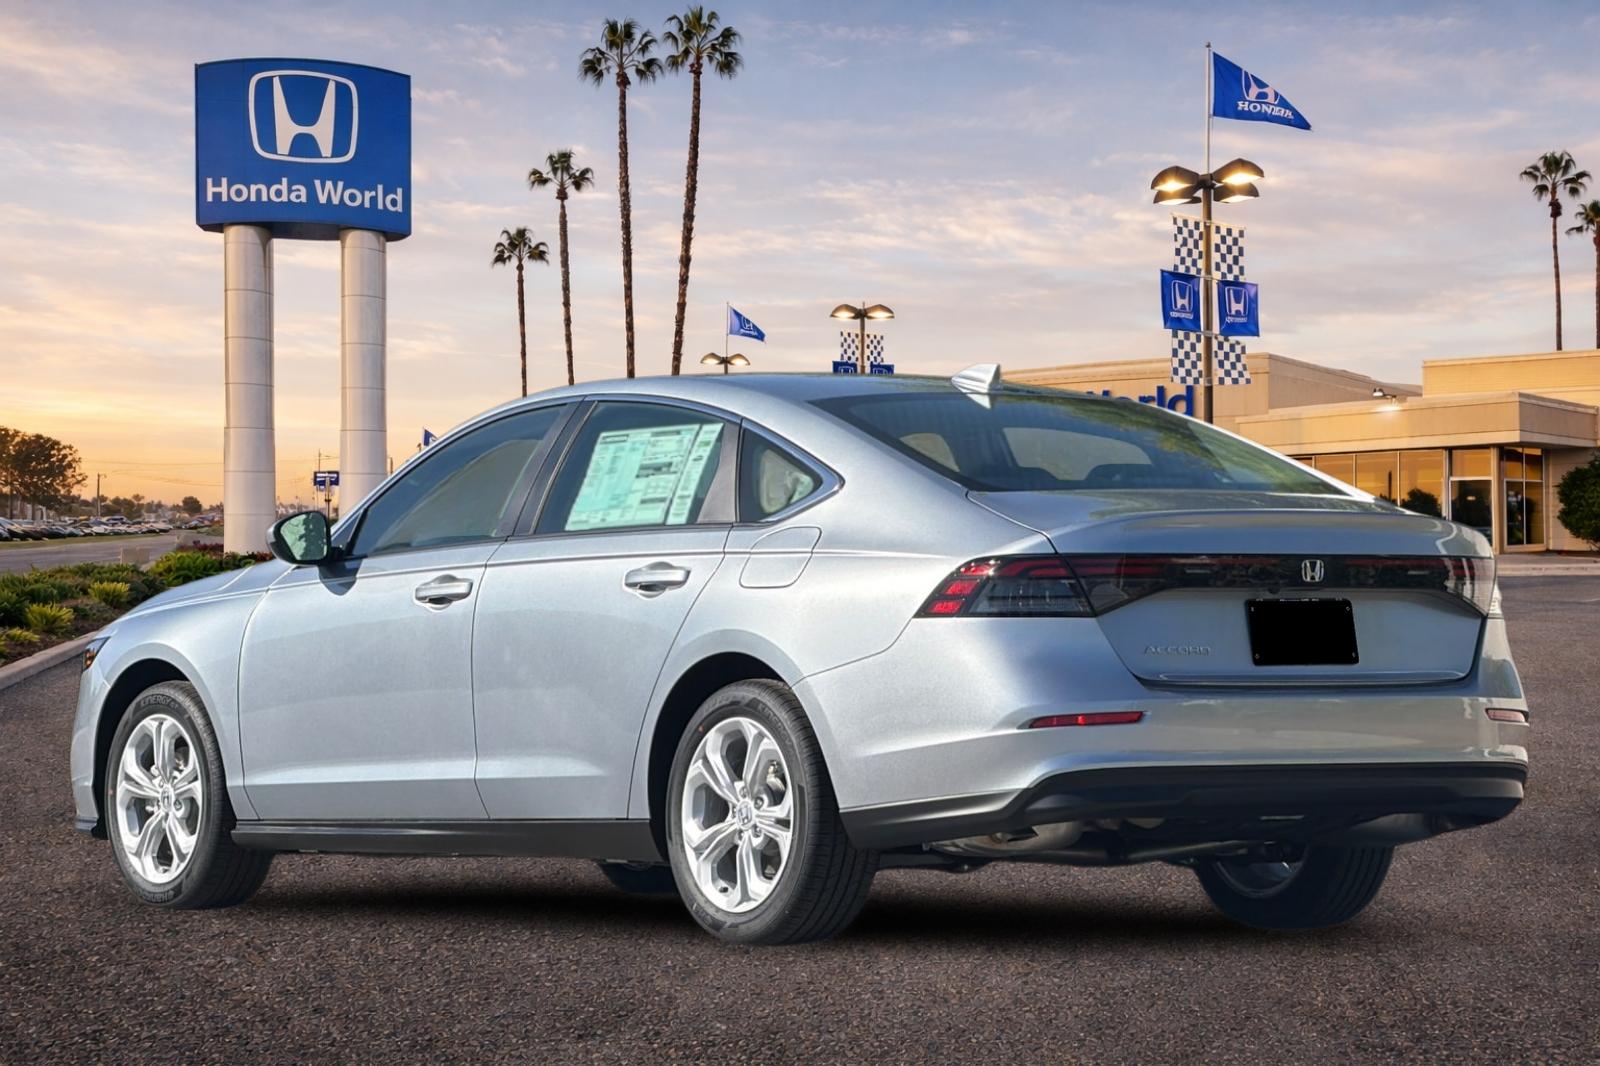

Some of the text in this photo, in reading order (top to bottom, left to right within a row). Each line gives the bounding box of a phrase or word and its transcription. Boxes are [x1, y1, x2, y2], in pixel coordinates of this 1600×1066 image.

[206, 177, 403, 213] Honda World
[1144, 645, 1210, 655] ACCORD
